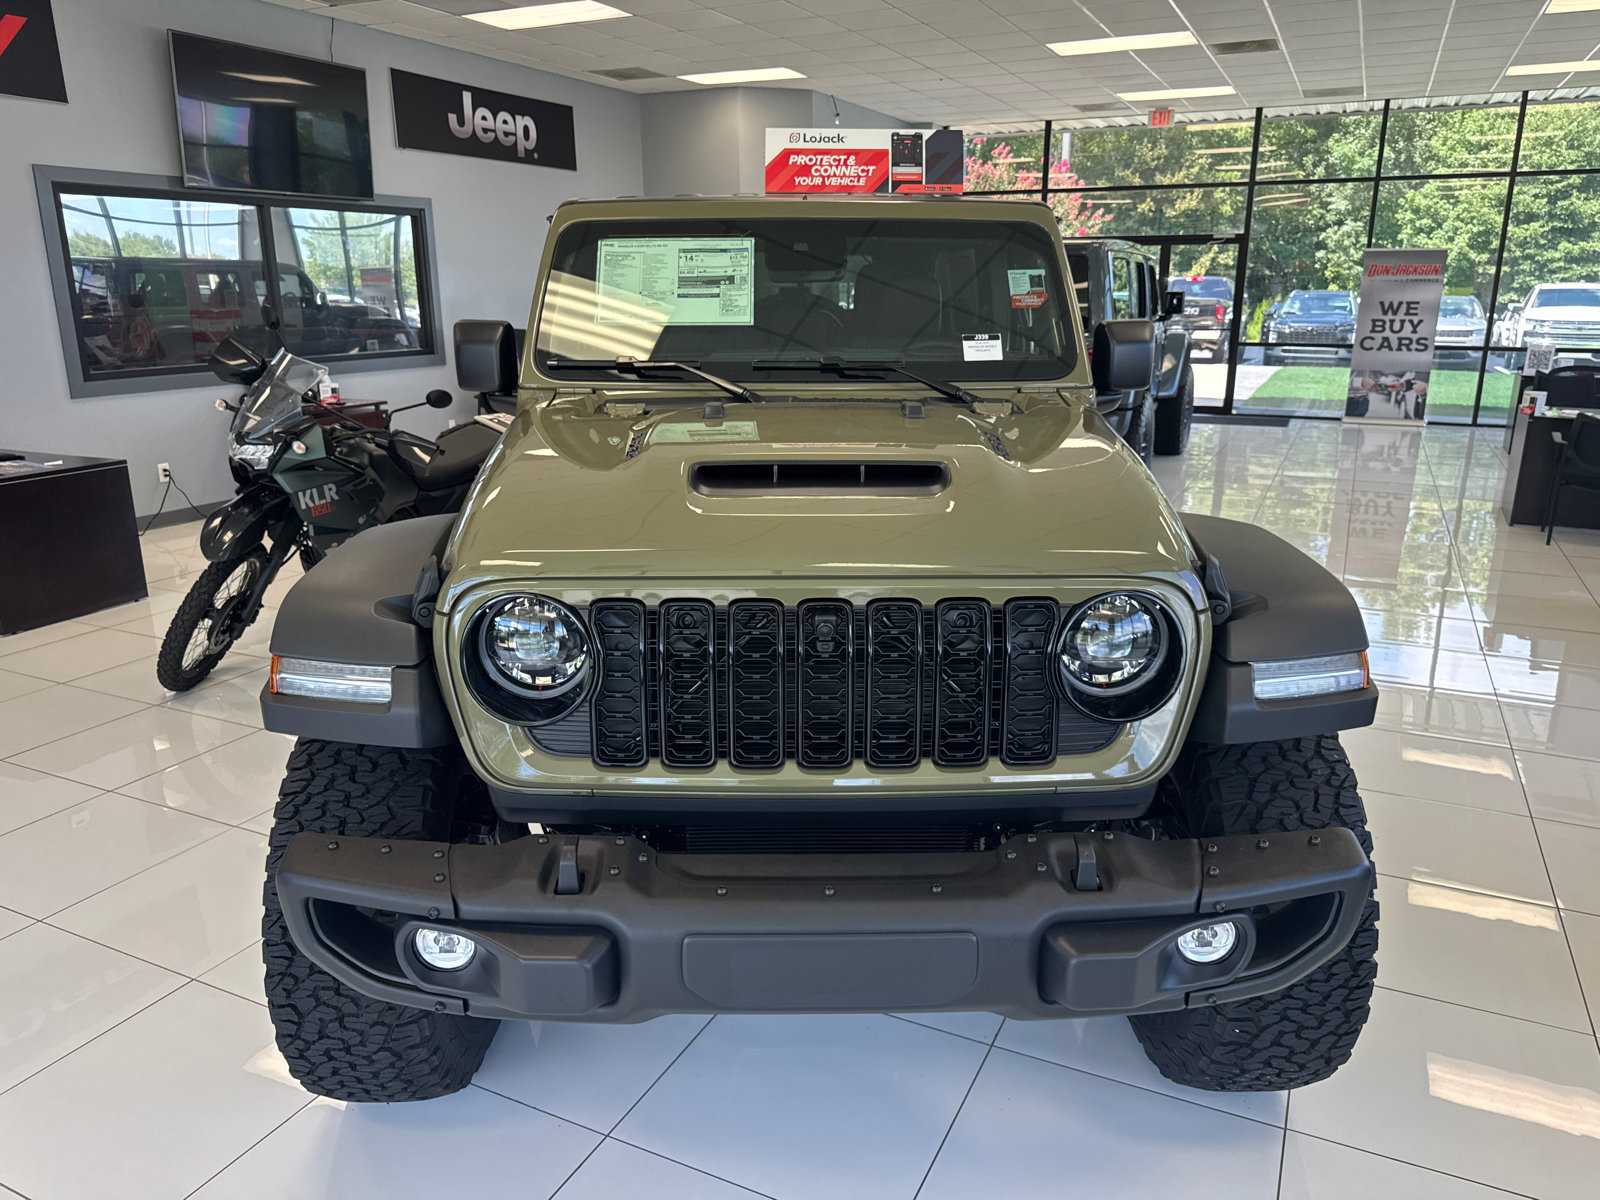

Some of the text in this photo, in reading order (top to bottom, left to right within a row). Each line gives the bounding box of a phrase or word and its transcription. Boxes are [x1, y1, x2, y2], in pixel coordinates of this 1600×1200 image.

[447, 90, 537, 158] Jeep
[1151, 109, 1172, 126] EXIT
[788, 154, 856, 165] PROTECT &
[811, 165, 876, 176] CONNECT
[794, 176, 867, 186] YOUR VEHICLE
[1367, 263, 1441, 278] DON JACKSON
[1379, 300, 1421, 316] WE
[1369, 318, 1424, 335] BUY
[1359, 336, 1430, 352] CARS
[297, 483, 340, 510] KLR
